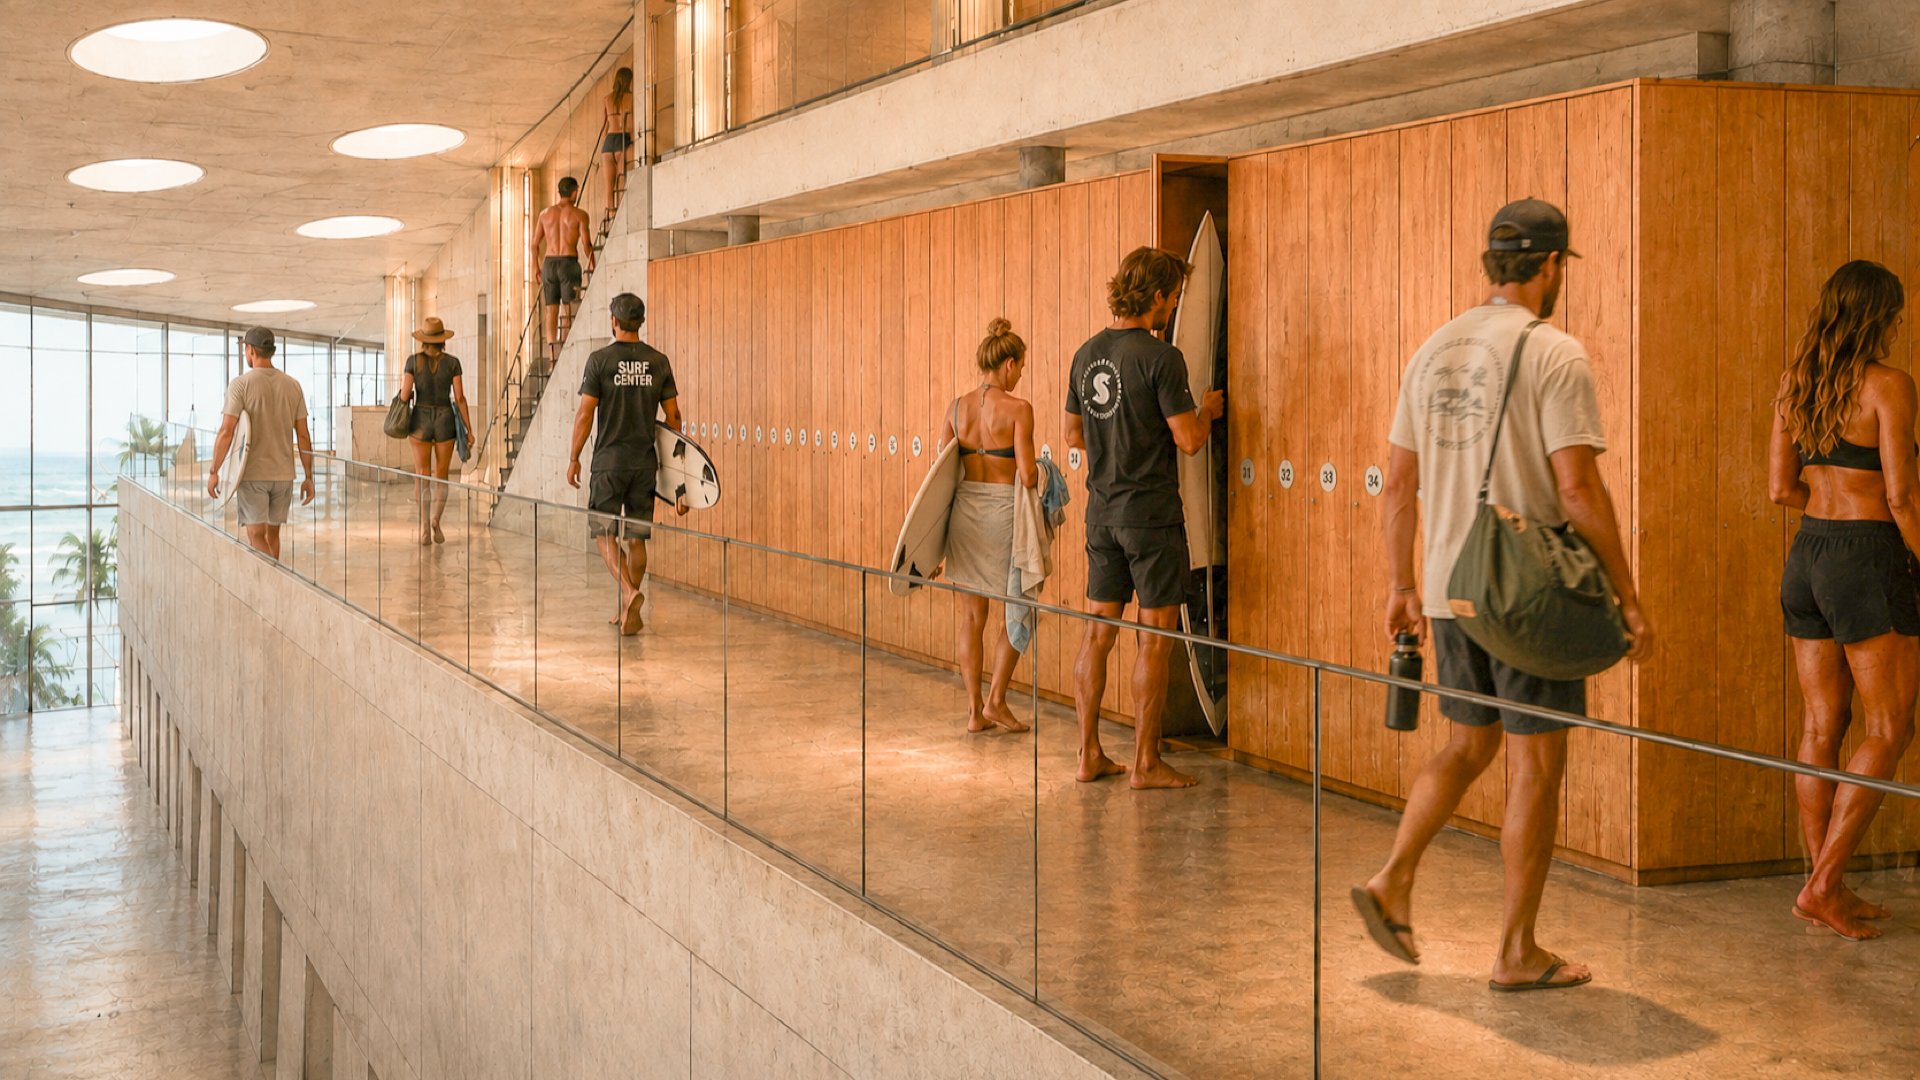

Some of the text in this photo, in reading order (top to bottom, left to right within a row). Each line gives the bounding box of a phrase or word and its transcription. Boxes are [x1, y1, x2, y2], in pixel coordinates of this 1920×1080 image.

[617, 360, 650, 375] SURF
[613, 373, 653, 387] CENTER
[1280, 468, 1292, 482] 32
[1322, 470, 1334, 484] 33
[1367, 474, 1379, 488] 34
